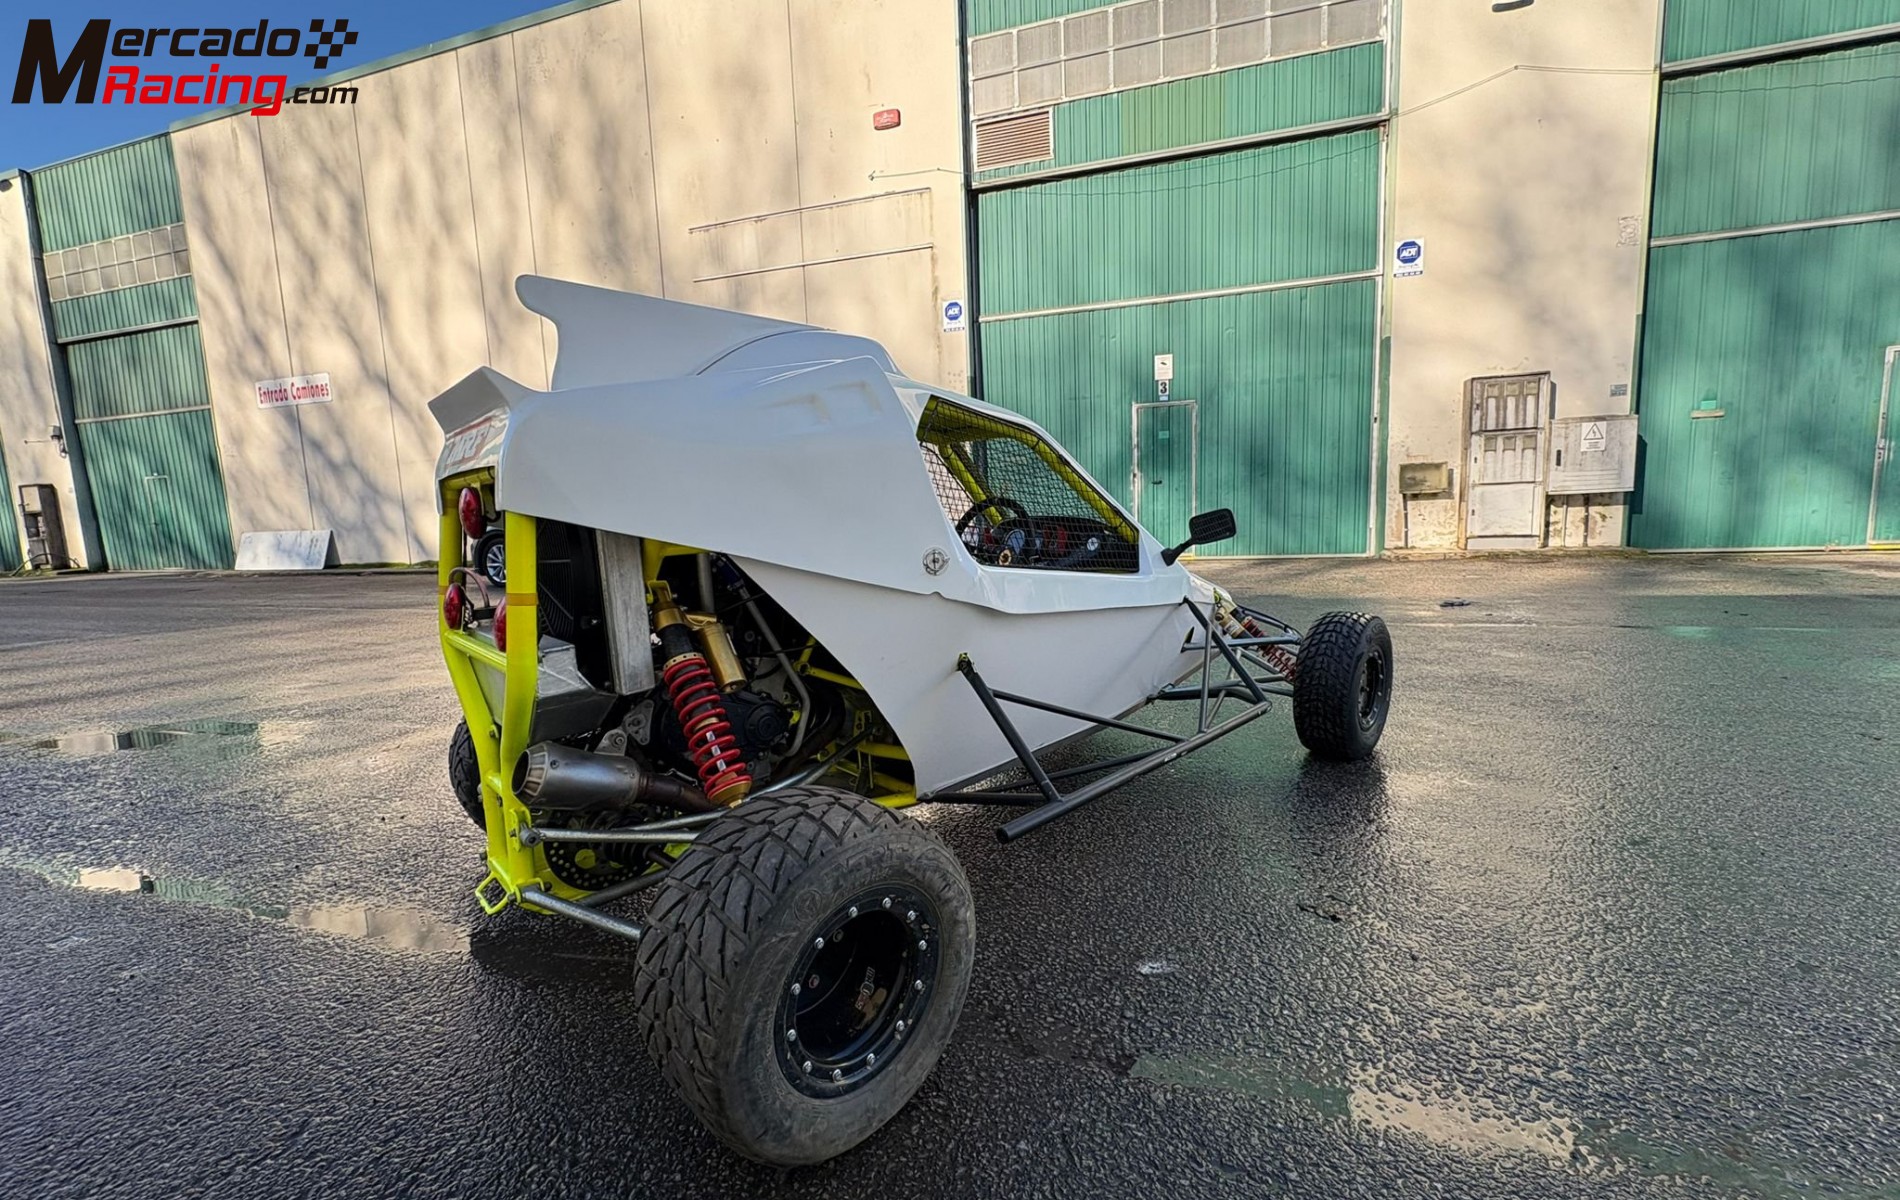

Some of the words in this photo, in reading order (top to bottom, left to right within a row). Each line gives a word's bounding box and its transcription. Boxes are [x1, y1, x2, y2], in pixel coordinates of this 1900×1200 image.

[258, 383, 289, 404] Entrada
[290, 380, 329, 401] Camiones
[1160, 381, 1167, 394] 3
